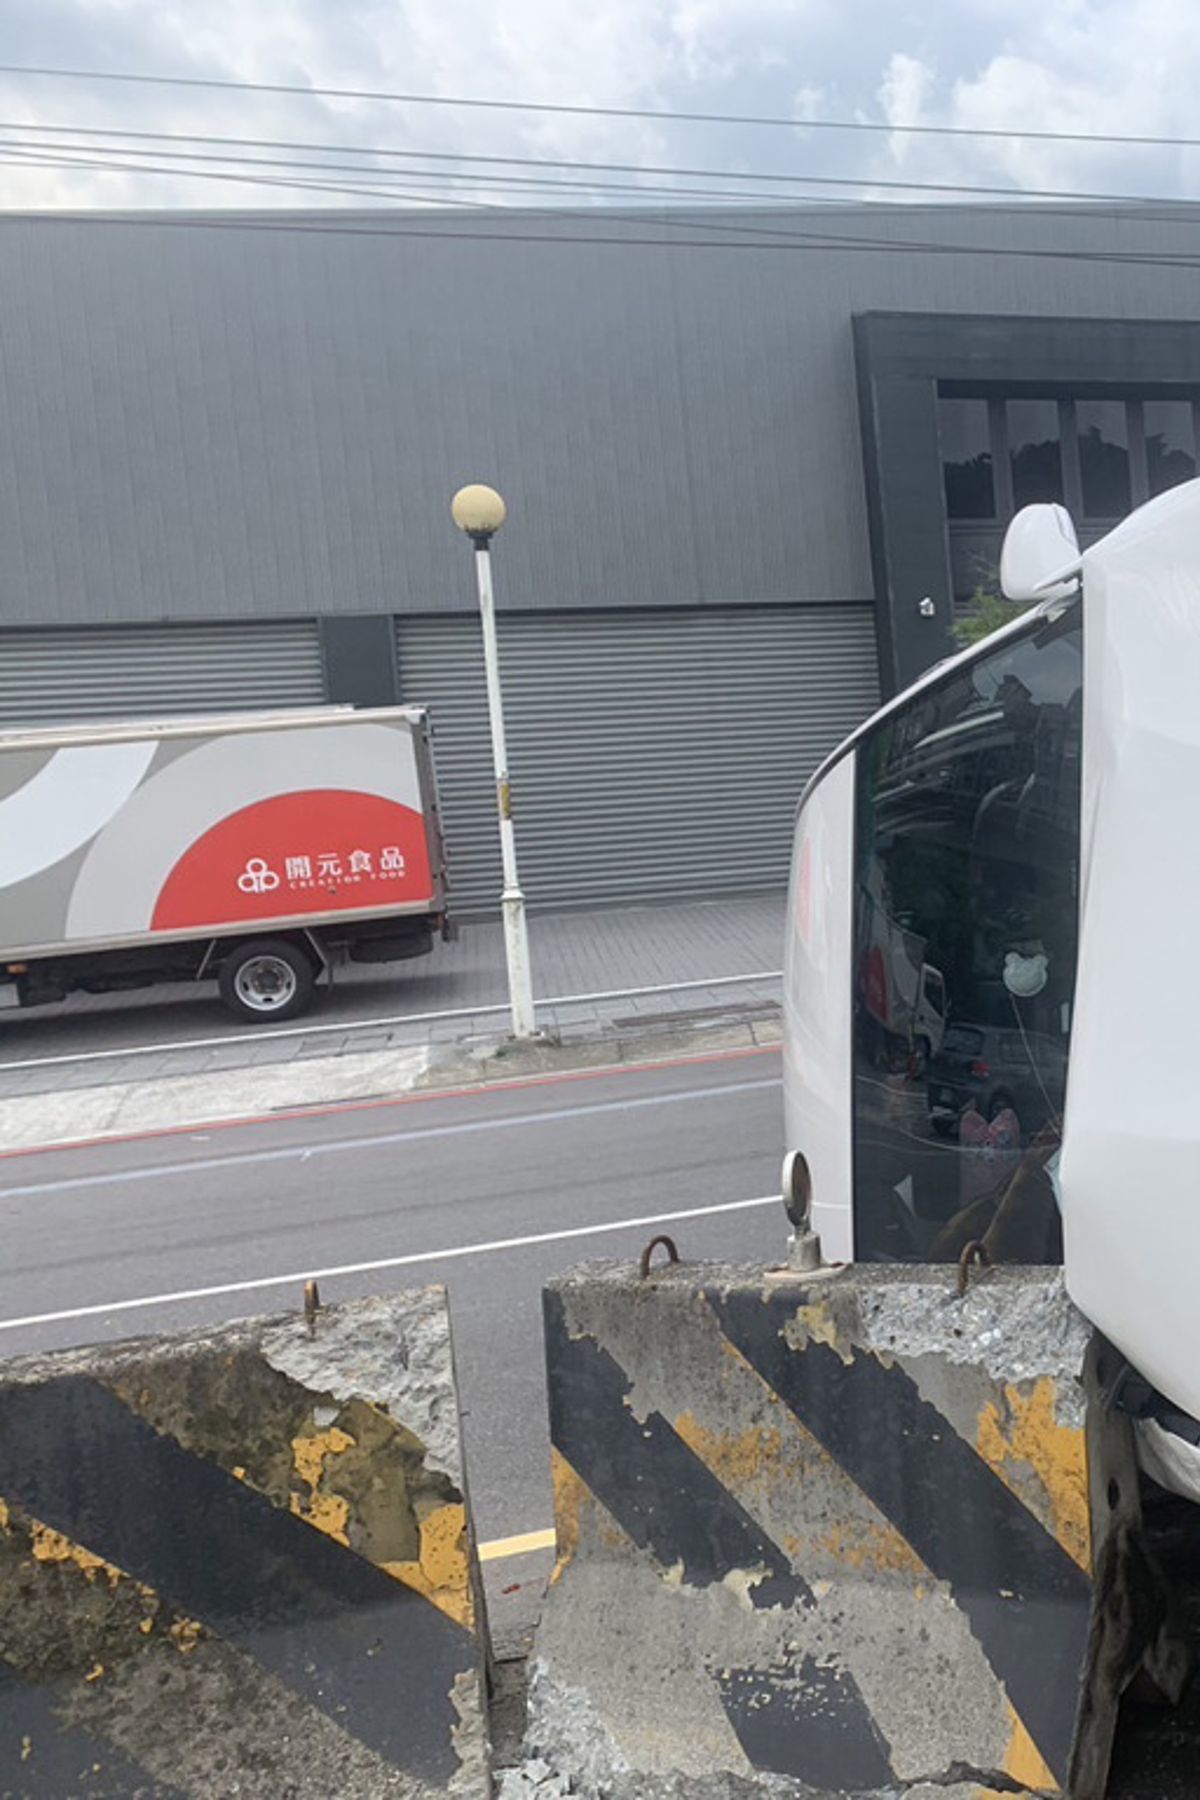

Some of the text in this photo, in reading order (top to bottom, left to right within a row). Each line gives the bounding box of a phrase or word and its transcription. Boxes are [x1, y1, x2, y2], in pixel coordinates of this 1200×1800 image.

[285, 846, 405, 880] 開元食品
[370, 870, 406, 880] FOOD
